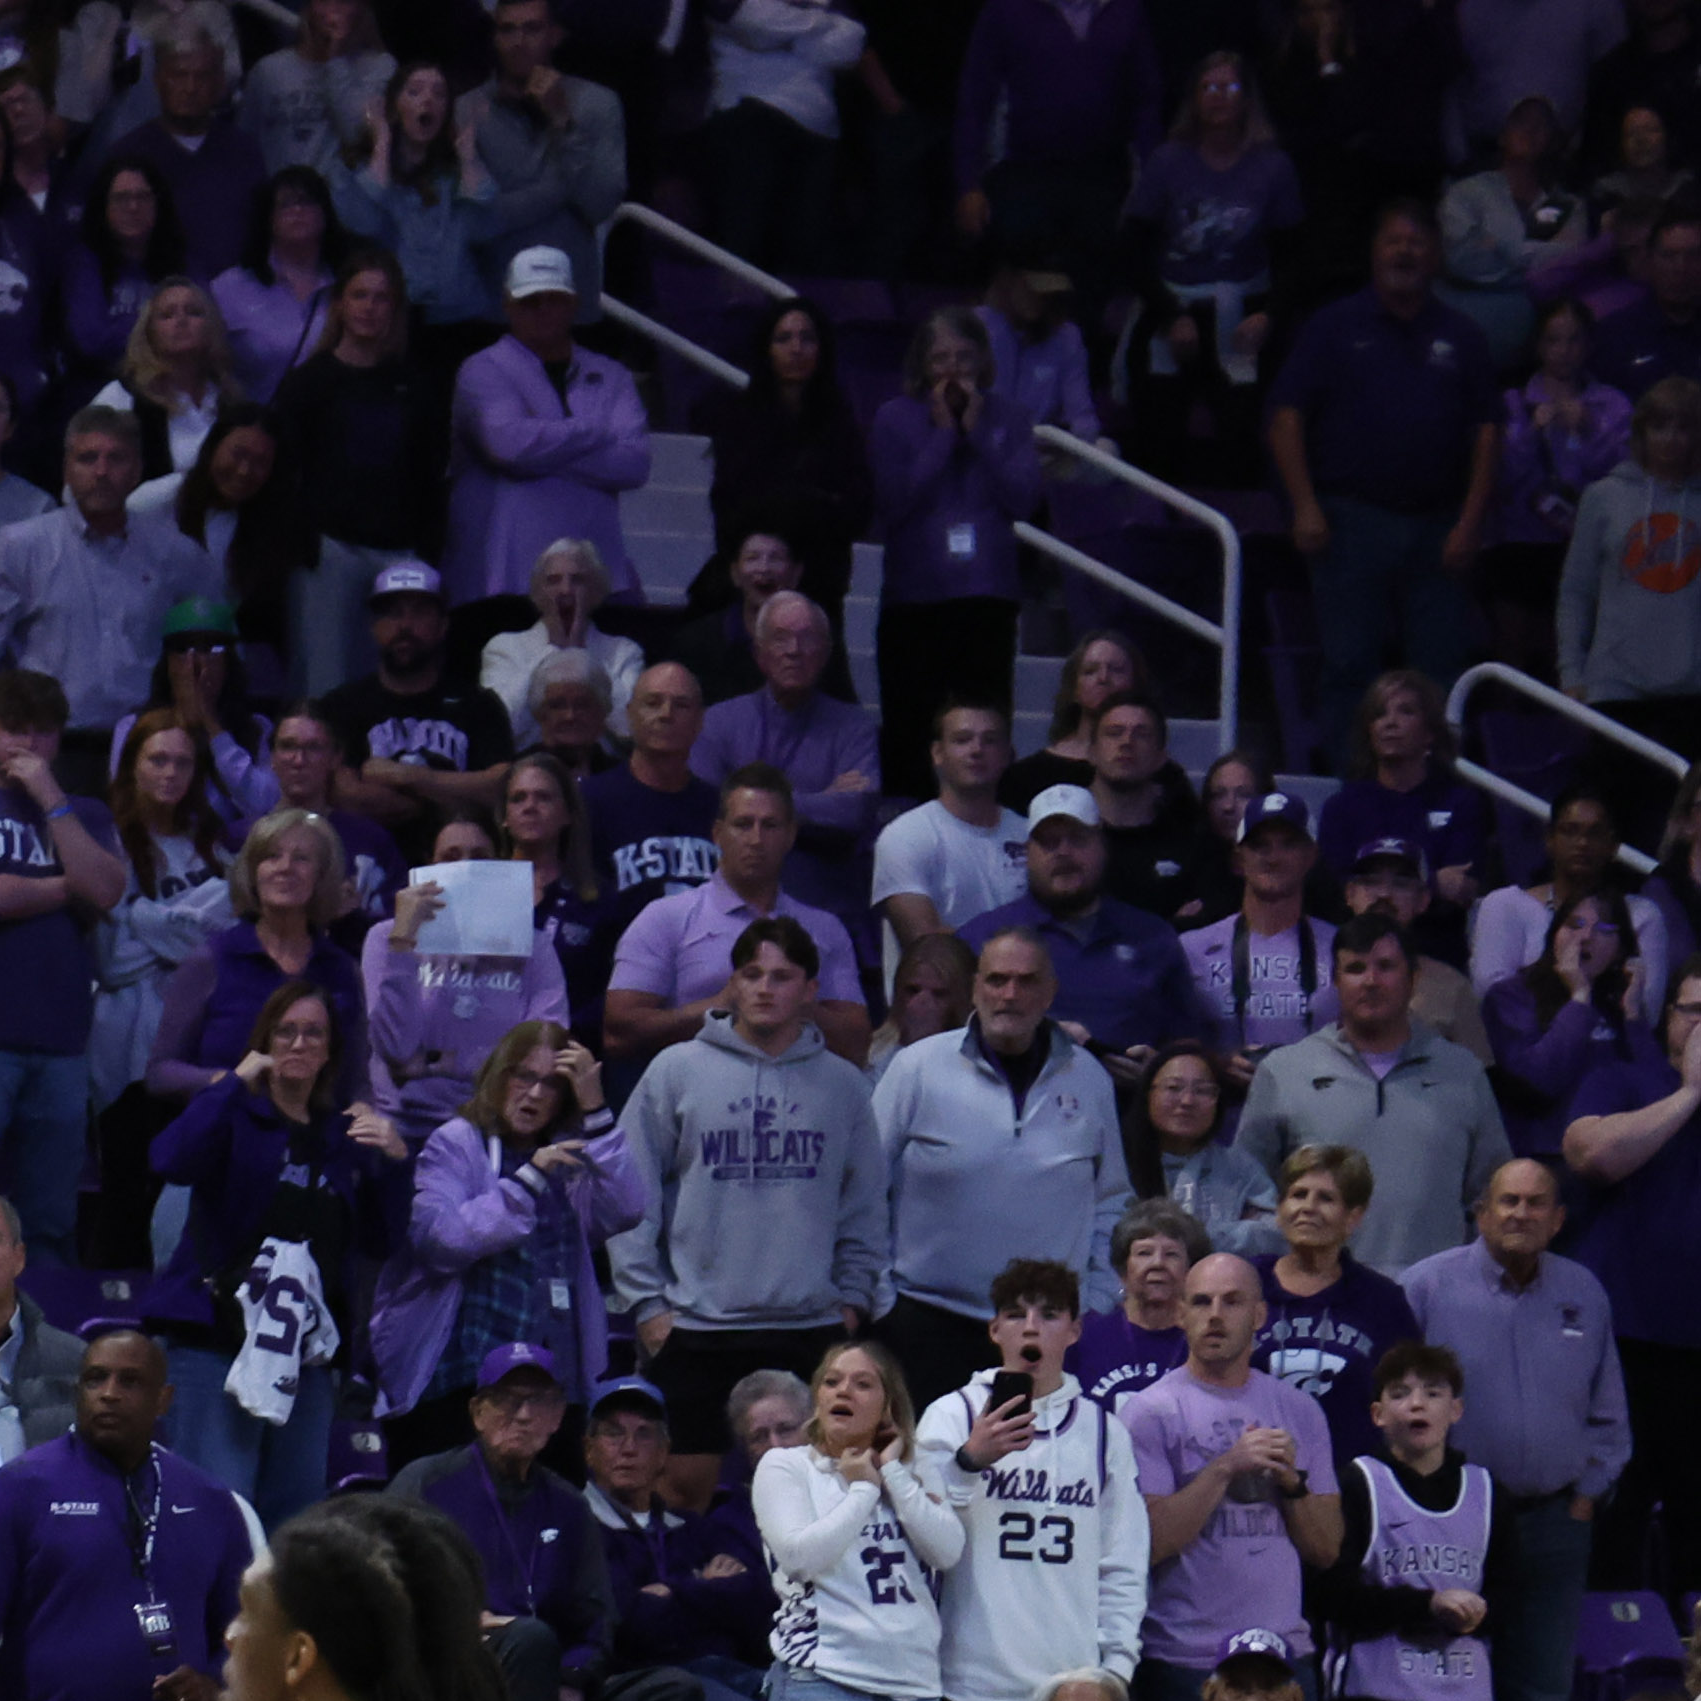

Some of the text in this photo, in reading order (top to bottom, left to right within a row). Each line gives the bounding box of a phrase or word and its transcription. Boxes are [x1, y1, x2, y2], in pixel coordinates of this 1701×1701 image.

[613, 836, 722, 892] K-STAT
[1205, 955, 1334, 989] KNSS
[700, 1130, 826, 1167] WILDCATS
[1253, 1317, 1375, 1360] -STATE
[979, 1465, 1097, 1509] Wildats
[999, 1511, 1076, 1565] 23
[1397, 1647, 1477, 1680] STATE
